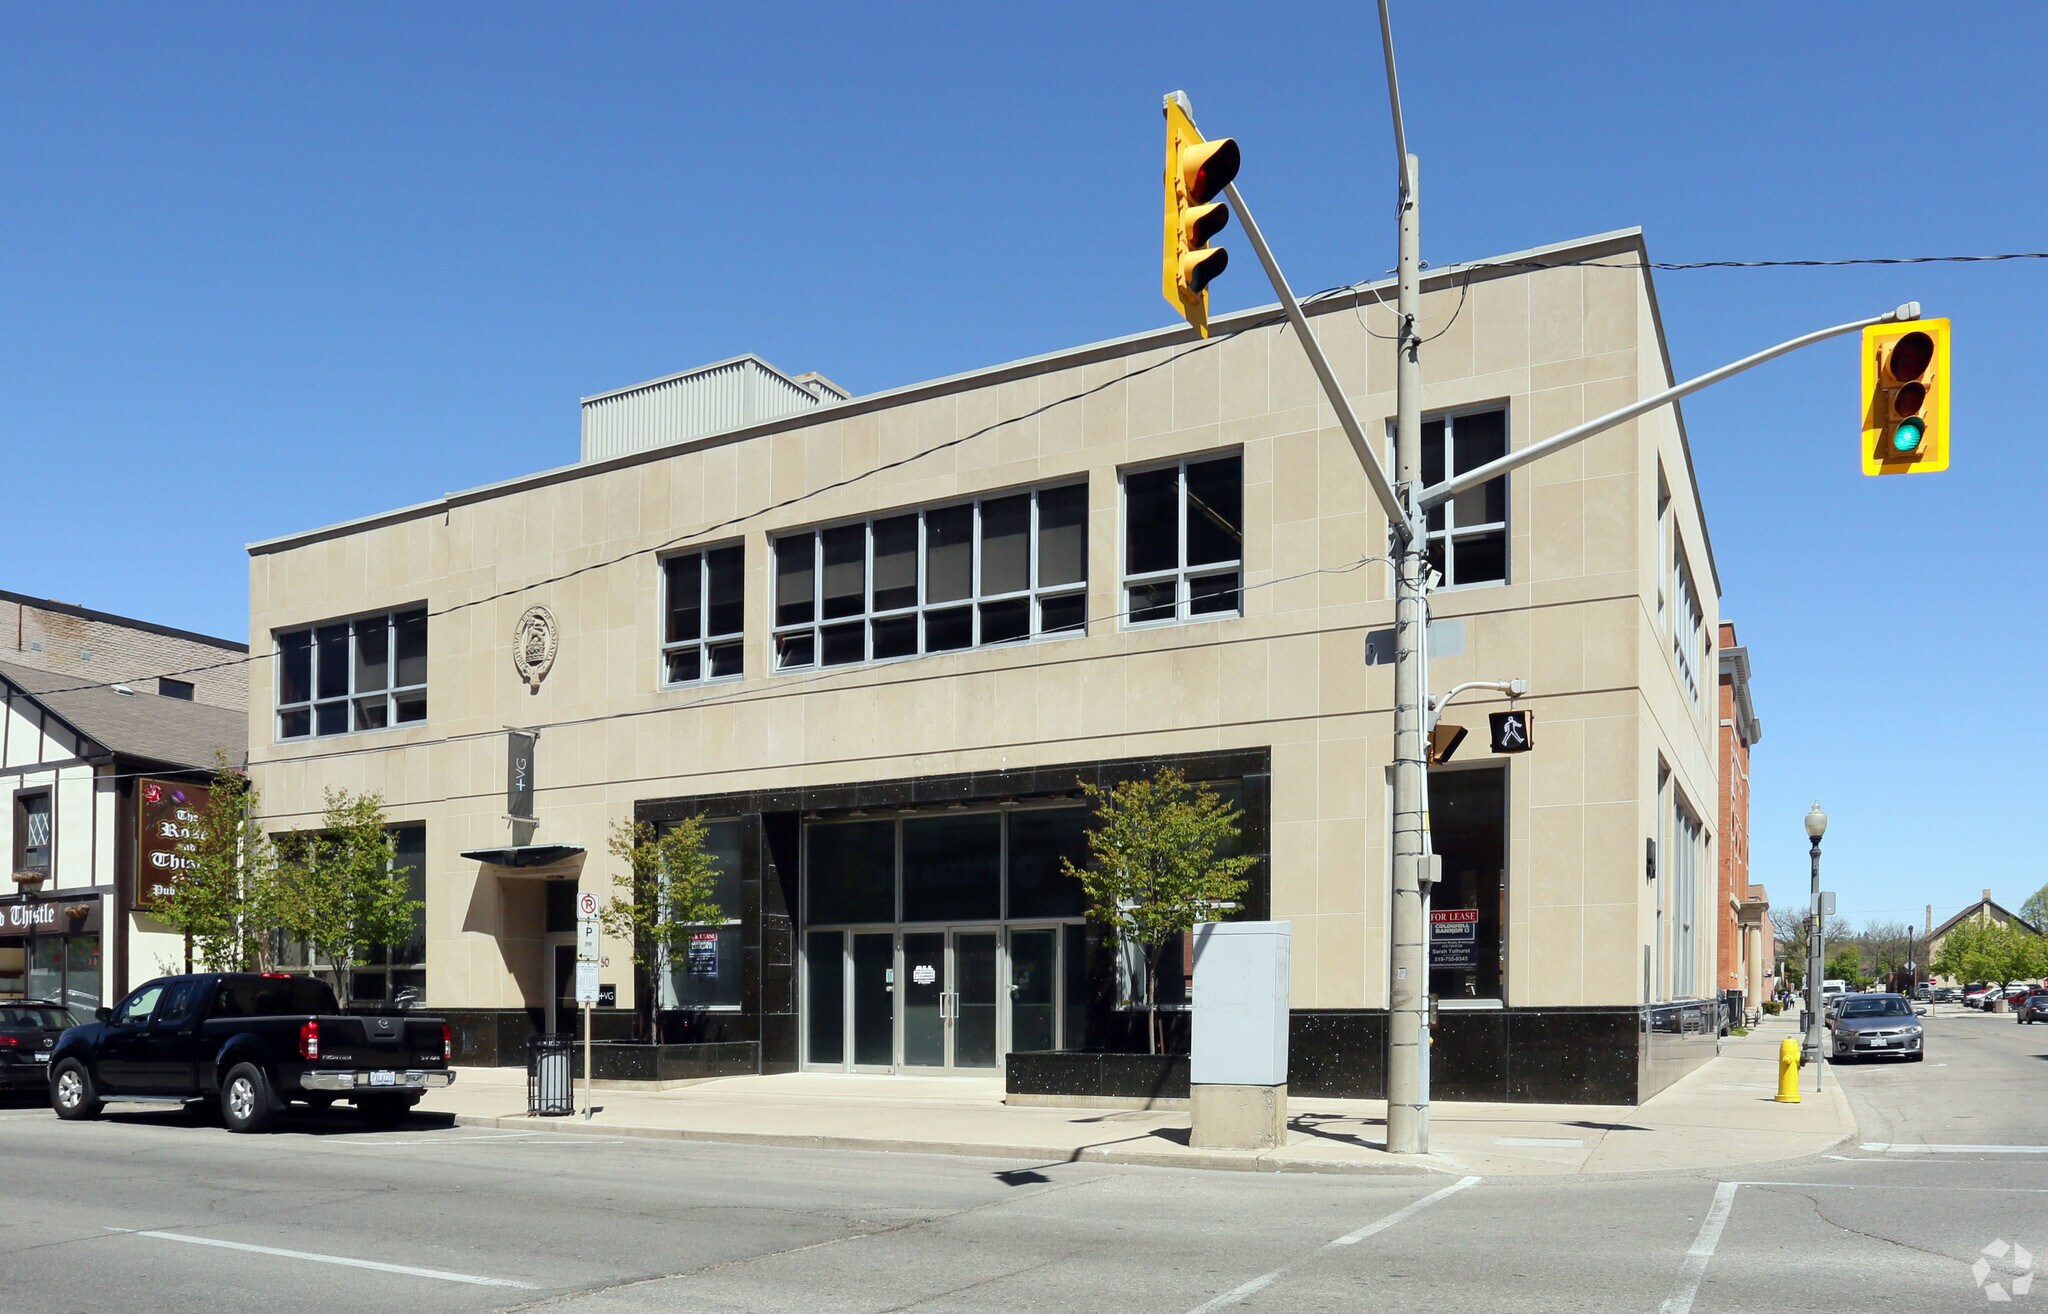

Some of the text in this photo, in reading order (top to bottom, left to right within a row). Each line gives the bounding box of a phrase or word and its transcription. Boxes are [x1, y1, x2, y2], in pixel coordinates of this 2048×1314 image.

[176, 809, 199, 822] The
[10, 903, 55, 929] Thistle
[1431, 912, 1476, 921] FOR LEASE
[586, 927, 593, 937] P
